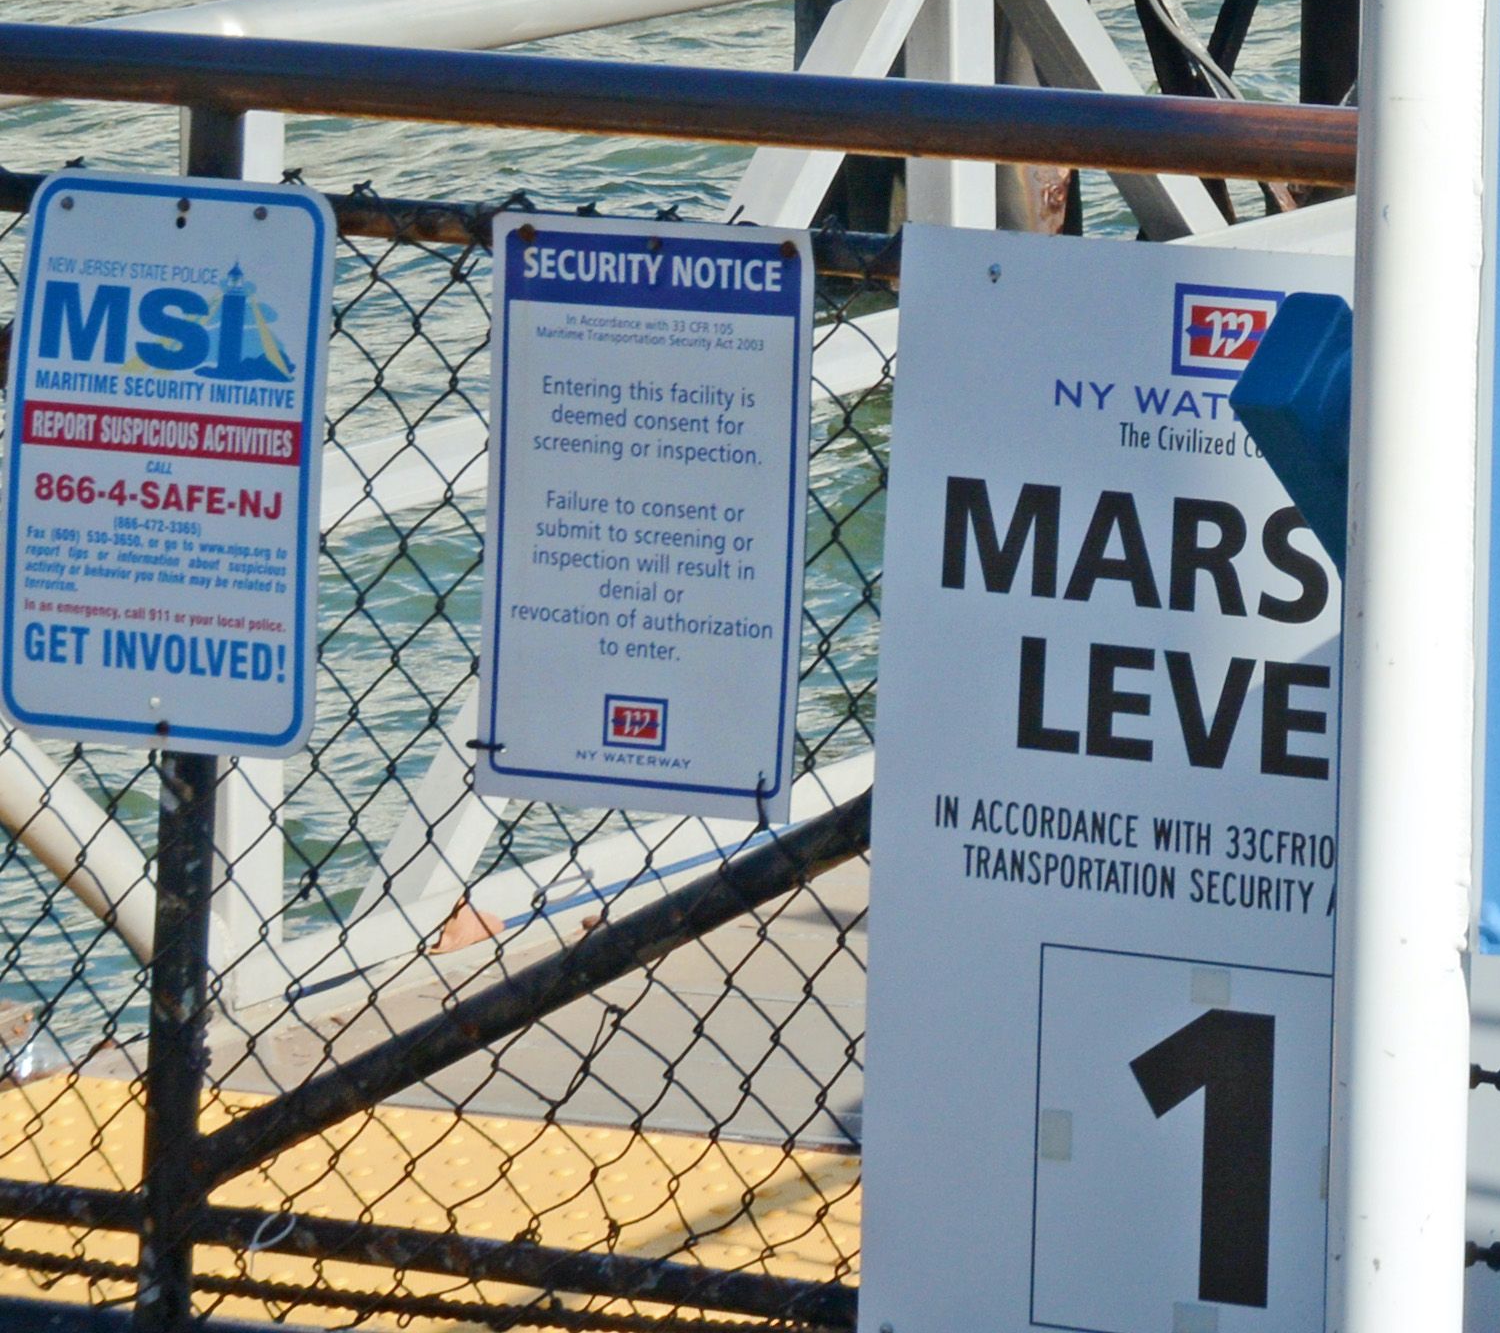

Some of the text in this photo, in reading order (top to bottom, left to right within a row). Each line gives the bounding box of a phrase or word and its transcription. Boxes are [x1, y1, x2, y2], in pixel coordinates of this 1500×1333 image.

[49, 256, 219, 286] NEW JERSEY STATE POLICE
[523, 245, 783, 293] SECURITY NOTICE
[39, 279, 262, 382] MSI
[35, 370, 296, 409] MARITIME SECURITY INITIATIVE
[542, 375, 756, 412] Entering this facility is
[1054, 379, 1241, 422] NY WAT
[32, 410, 293, 459] REPORT SUSPICIOUS ACTIVITIES
[551, 404, 745, 435] deemed consent for
[1120, 422, 1151, 449] The
[1157, 425, 1236, 457] Civilized
[146, 460, 173, 475] CALL
[533, 434, 762, 466] screening or inspection.
[35, 472, 283, 520] 866-4-SAFE-NJ
[24, 621, 286, 684] GET INVOLVED!
[575, 749, 692, 770] NY WATERWAY
[935, 794, 960, 829] IN
[971, 798, 1140, 849] ACCORDANCE
[1153, 817, 1212, 857] WITH
[963, 843, 1177, 900] TRANSPORTATION
[1190, 866, 1315, 915] SECURITY
[1129, 1007, 1277, 1309] 1
